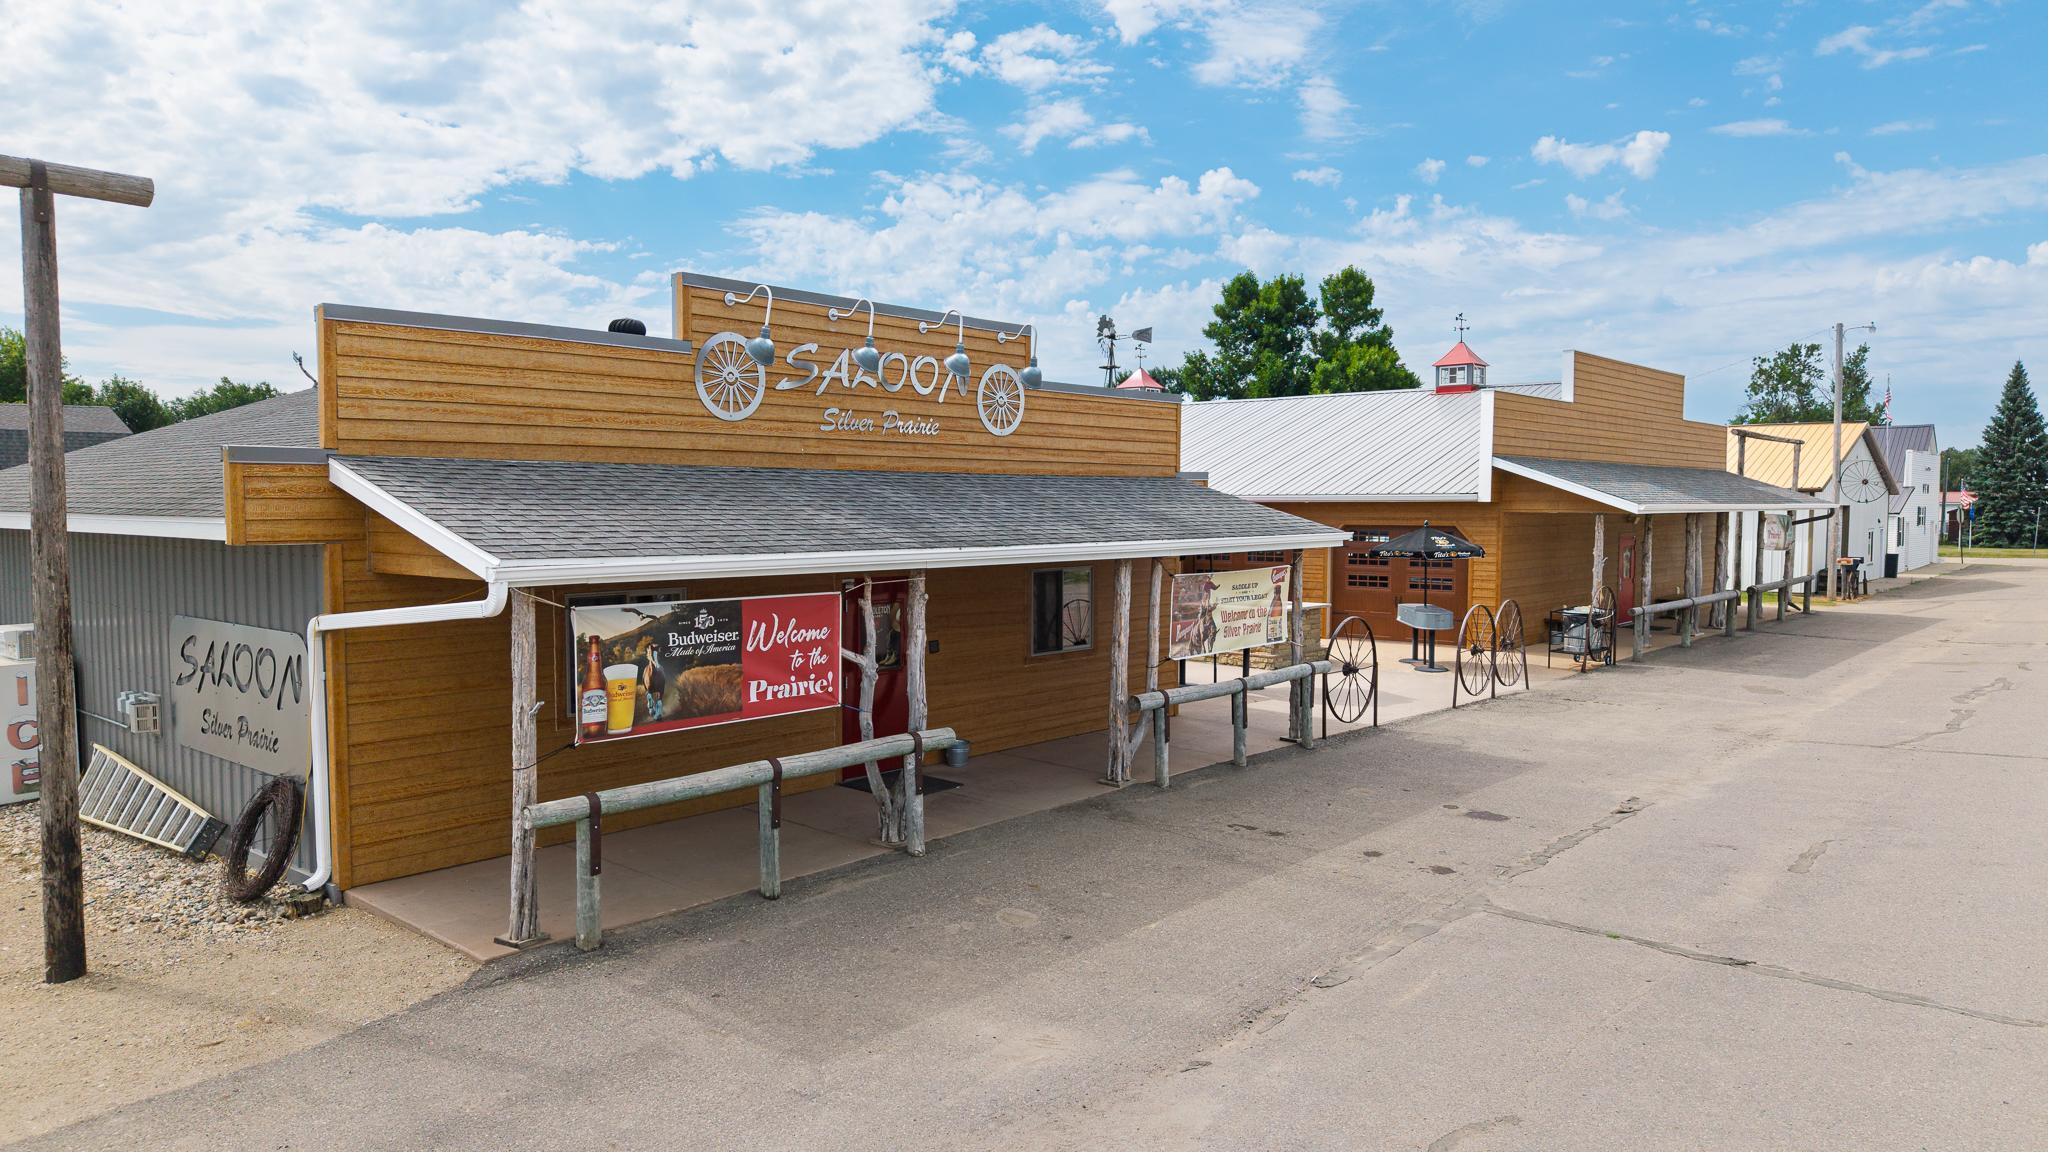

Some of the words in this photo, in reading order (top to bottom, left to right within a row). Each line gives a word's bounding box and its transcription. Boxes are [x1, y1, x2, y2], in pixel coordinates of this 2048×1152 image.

[820, 407, 875, 432] Silver
[882, 409, 940, 436] Prairie
[1221, 609, 1249, 623] Welcome
[1249, 608, 1256, 619] to
[1257, 606, 1268, 618] the
[667, 629, 739, 647] Budweiser
[746, 612, 831, 652] Welcome
[1224, 625, 1241, 638] Silver
[1243, 622, 1261, 635] Prairie
[664, 646, 695, 658] Made
[693, 645, 705, 657] of
[702, 643, 736, 655] America
[789, 649, 805, 671] to
[807, 646, 829, 669] the
[176, 635, 302, 711] SALOON
[748, 671, 833, 703] Prairie!
[7, 670, 41, 794] ICE
[201, 708, 233, 740] Silver
[237, 715, 280, 753] Prairie
